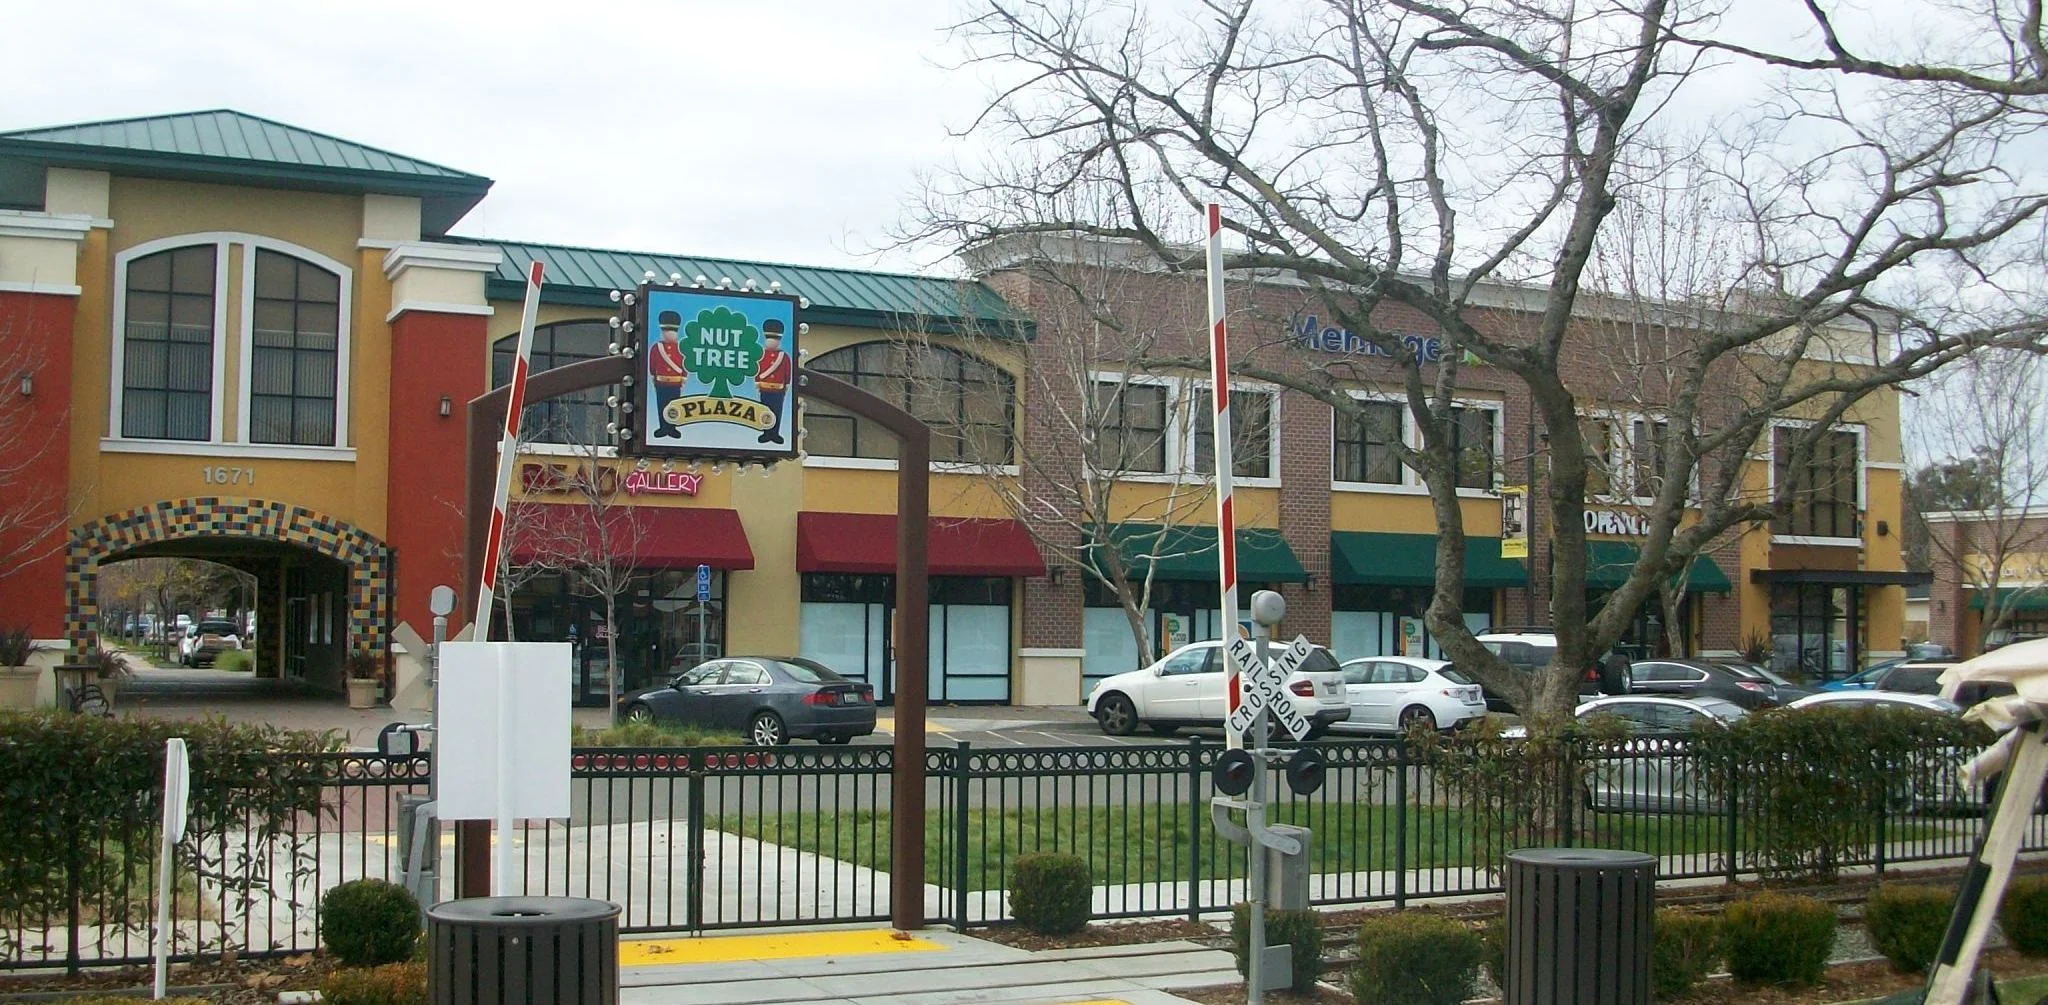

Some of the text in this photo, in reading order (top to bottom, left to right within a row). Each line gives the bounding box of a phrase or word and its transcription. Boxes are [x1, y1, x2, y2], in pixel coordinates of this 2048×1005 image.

[700, 327, 743, 347] NUT
[692, 347, 749, 369] TREE
[681, 400, 756, 422] PLAZA
[203, 466, 255, 485] 1671
[625, 471, 704, 496] GALLERY
[1230, 642, 1306, 731] CROSSING
